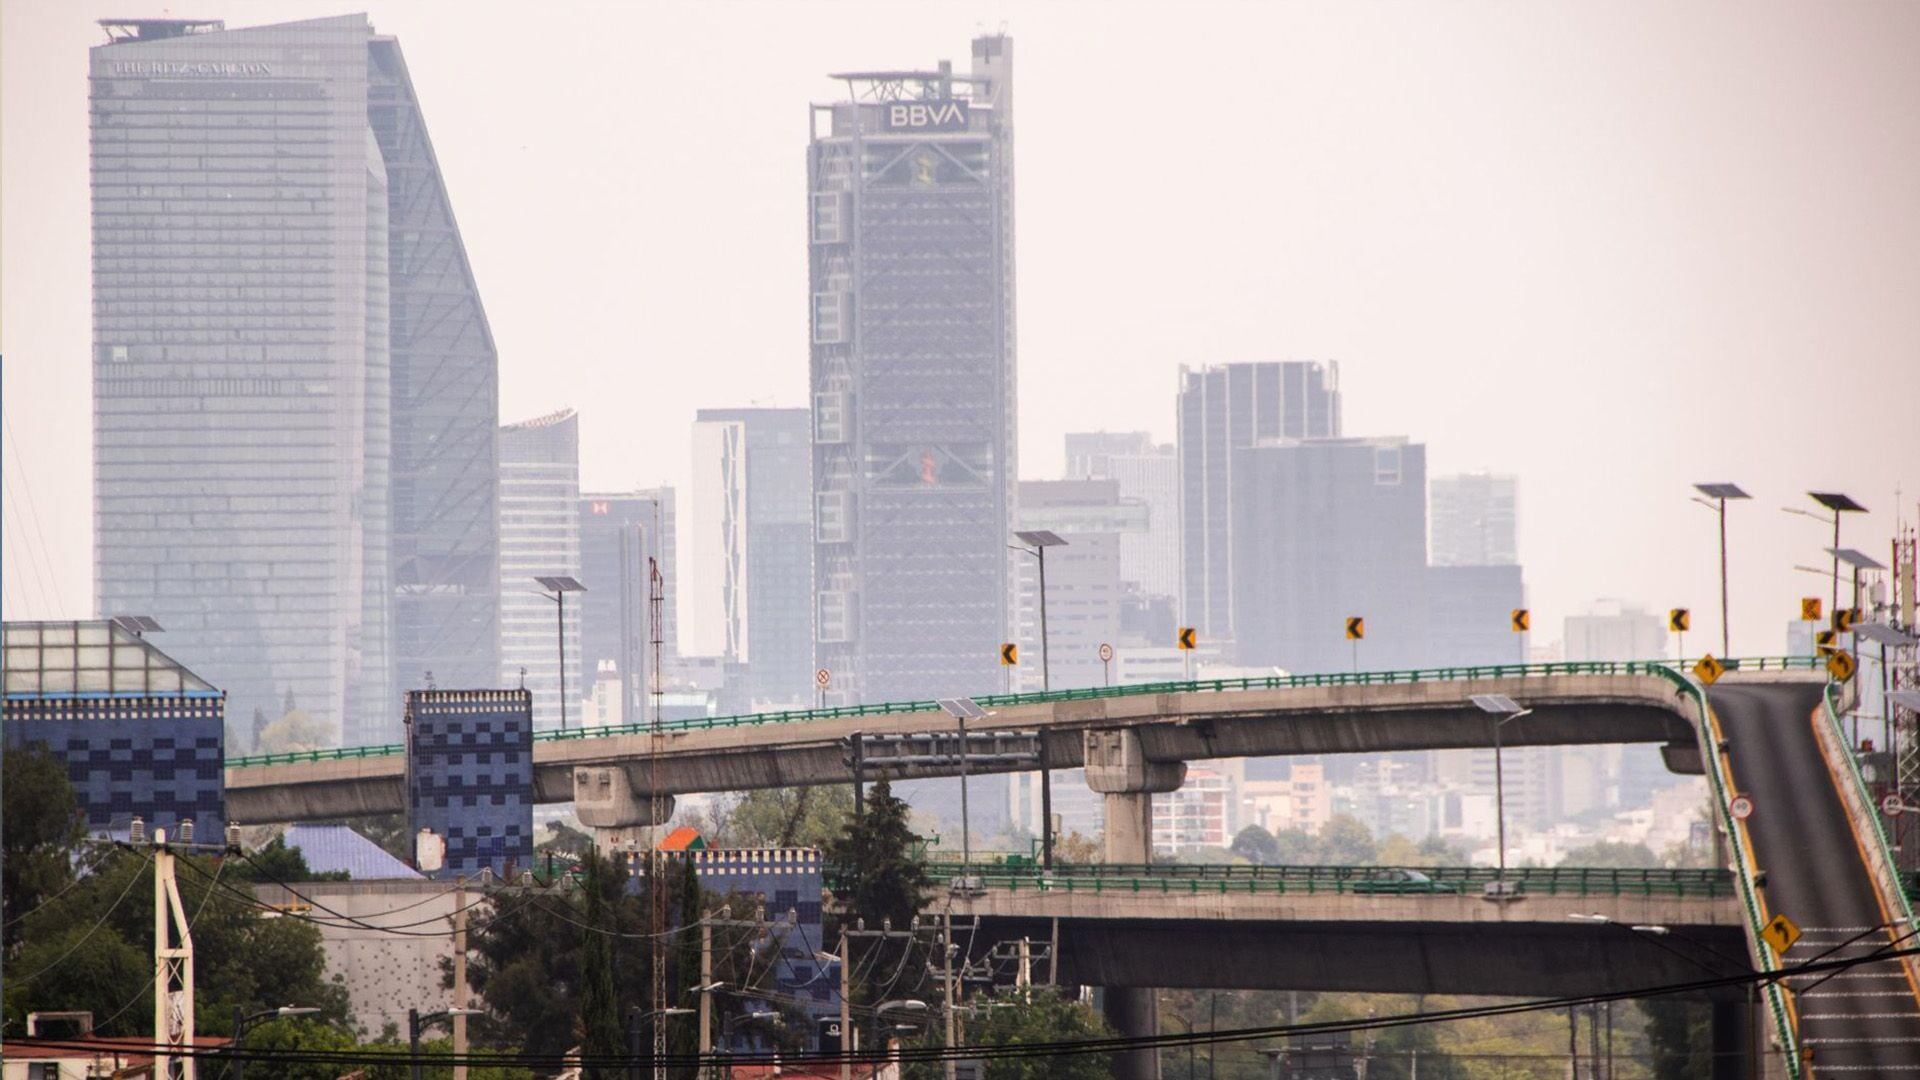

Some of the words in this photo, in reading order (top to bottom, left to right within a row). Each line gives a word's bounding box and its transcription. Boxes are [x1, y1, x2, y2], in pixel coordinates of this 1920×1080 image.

[115, 61, 145, 74] THE
[151, 61, 272, 75] RITZ-CARLTON
[890, 103, 965, 127] BBVA
